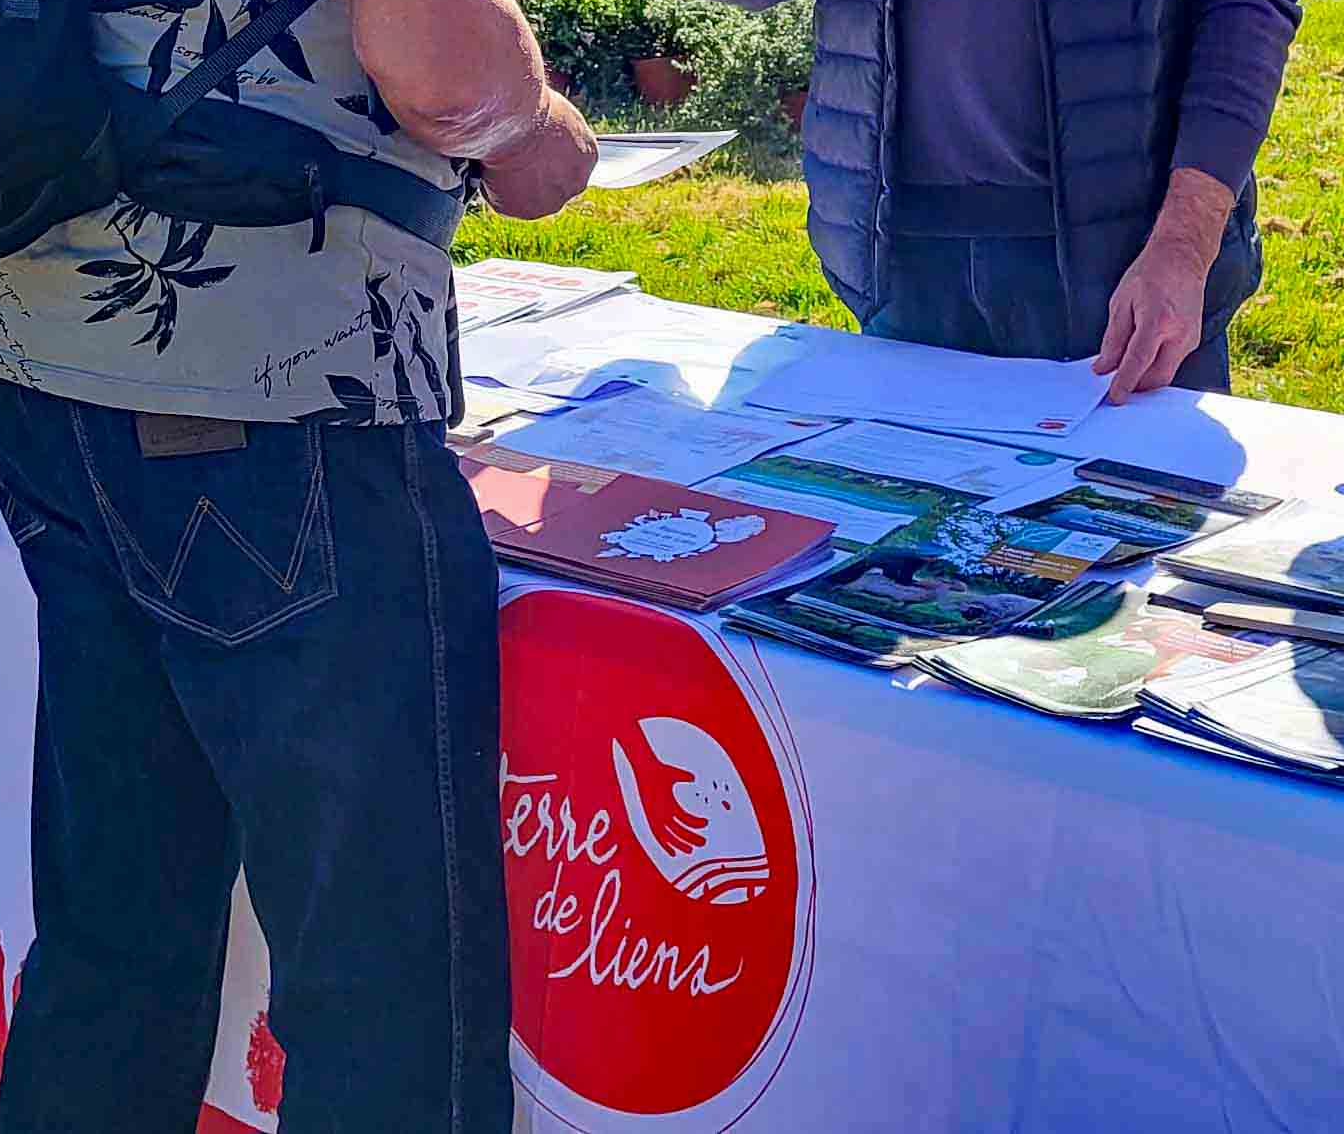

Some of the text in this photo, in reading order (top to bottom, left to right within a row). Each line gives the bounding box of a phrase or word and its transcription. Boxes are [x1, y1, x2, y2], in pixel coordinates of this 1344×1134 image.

[254, 309, 373, 399] if you want
[533, 862, 583, 936] de
[547, 868, 743, 997] liens
